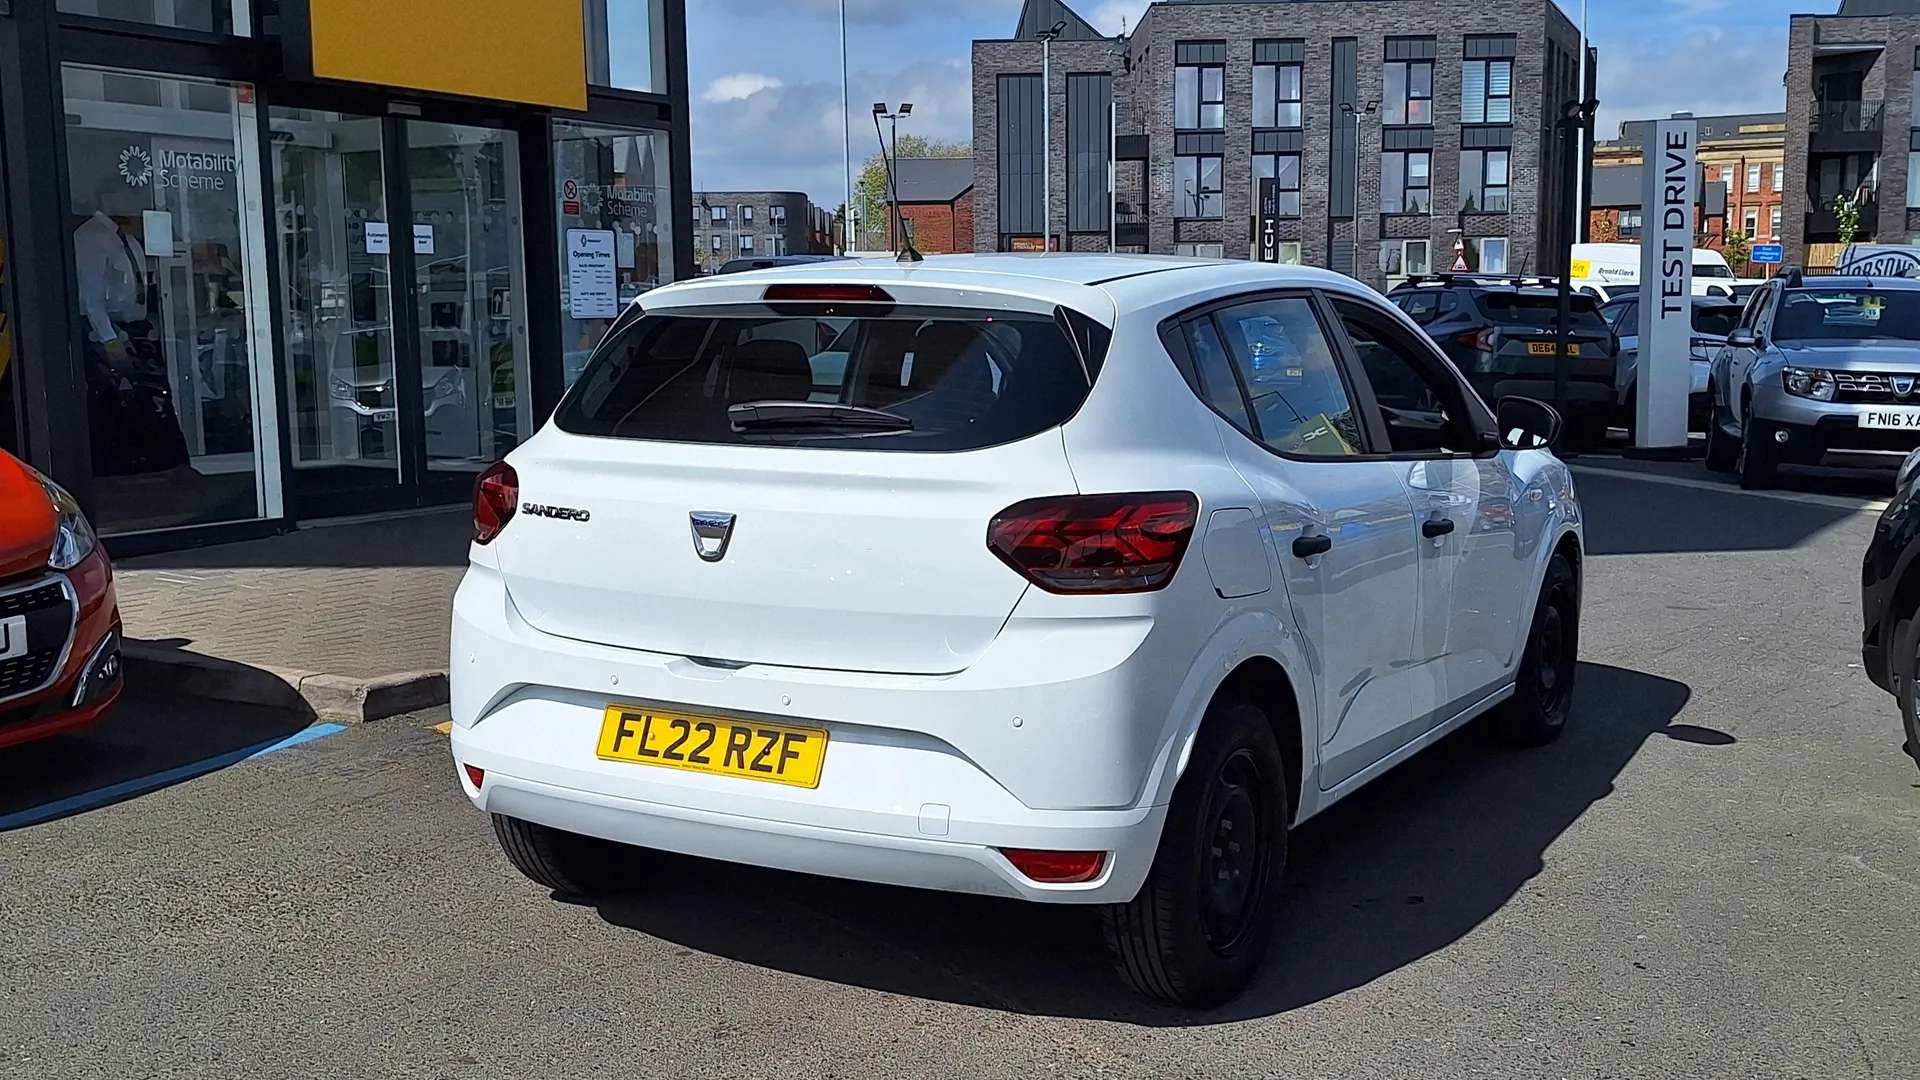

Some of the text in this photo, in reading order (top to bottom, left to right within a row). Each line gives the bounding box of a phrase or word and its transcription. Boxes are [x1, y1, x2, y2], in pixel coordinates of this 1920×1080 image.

[160, 150, 242, 177] Motability
[160, 170, 225, 190] Scheme
[606, 185, 656, 206] Motability
[607, 201, 648, 218] Scheme
[1661, 131, 1688, 320] TEST DRIVE
[572, 250, 594, 259] Opening
[1867, 412, 1901, 427] FN16
[521, 502, 590, 522] SANDERO
[612, 711, 808, 775] FL22 RZF
